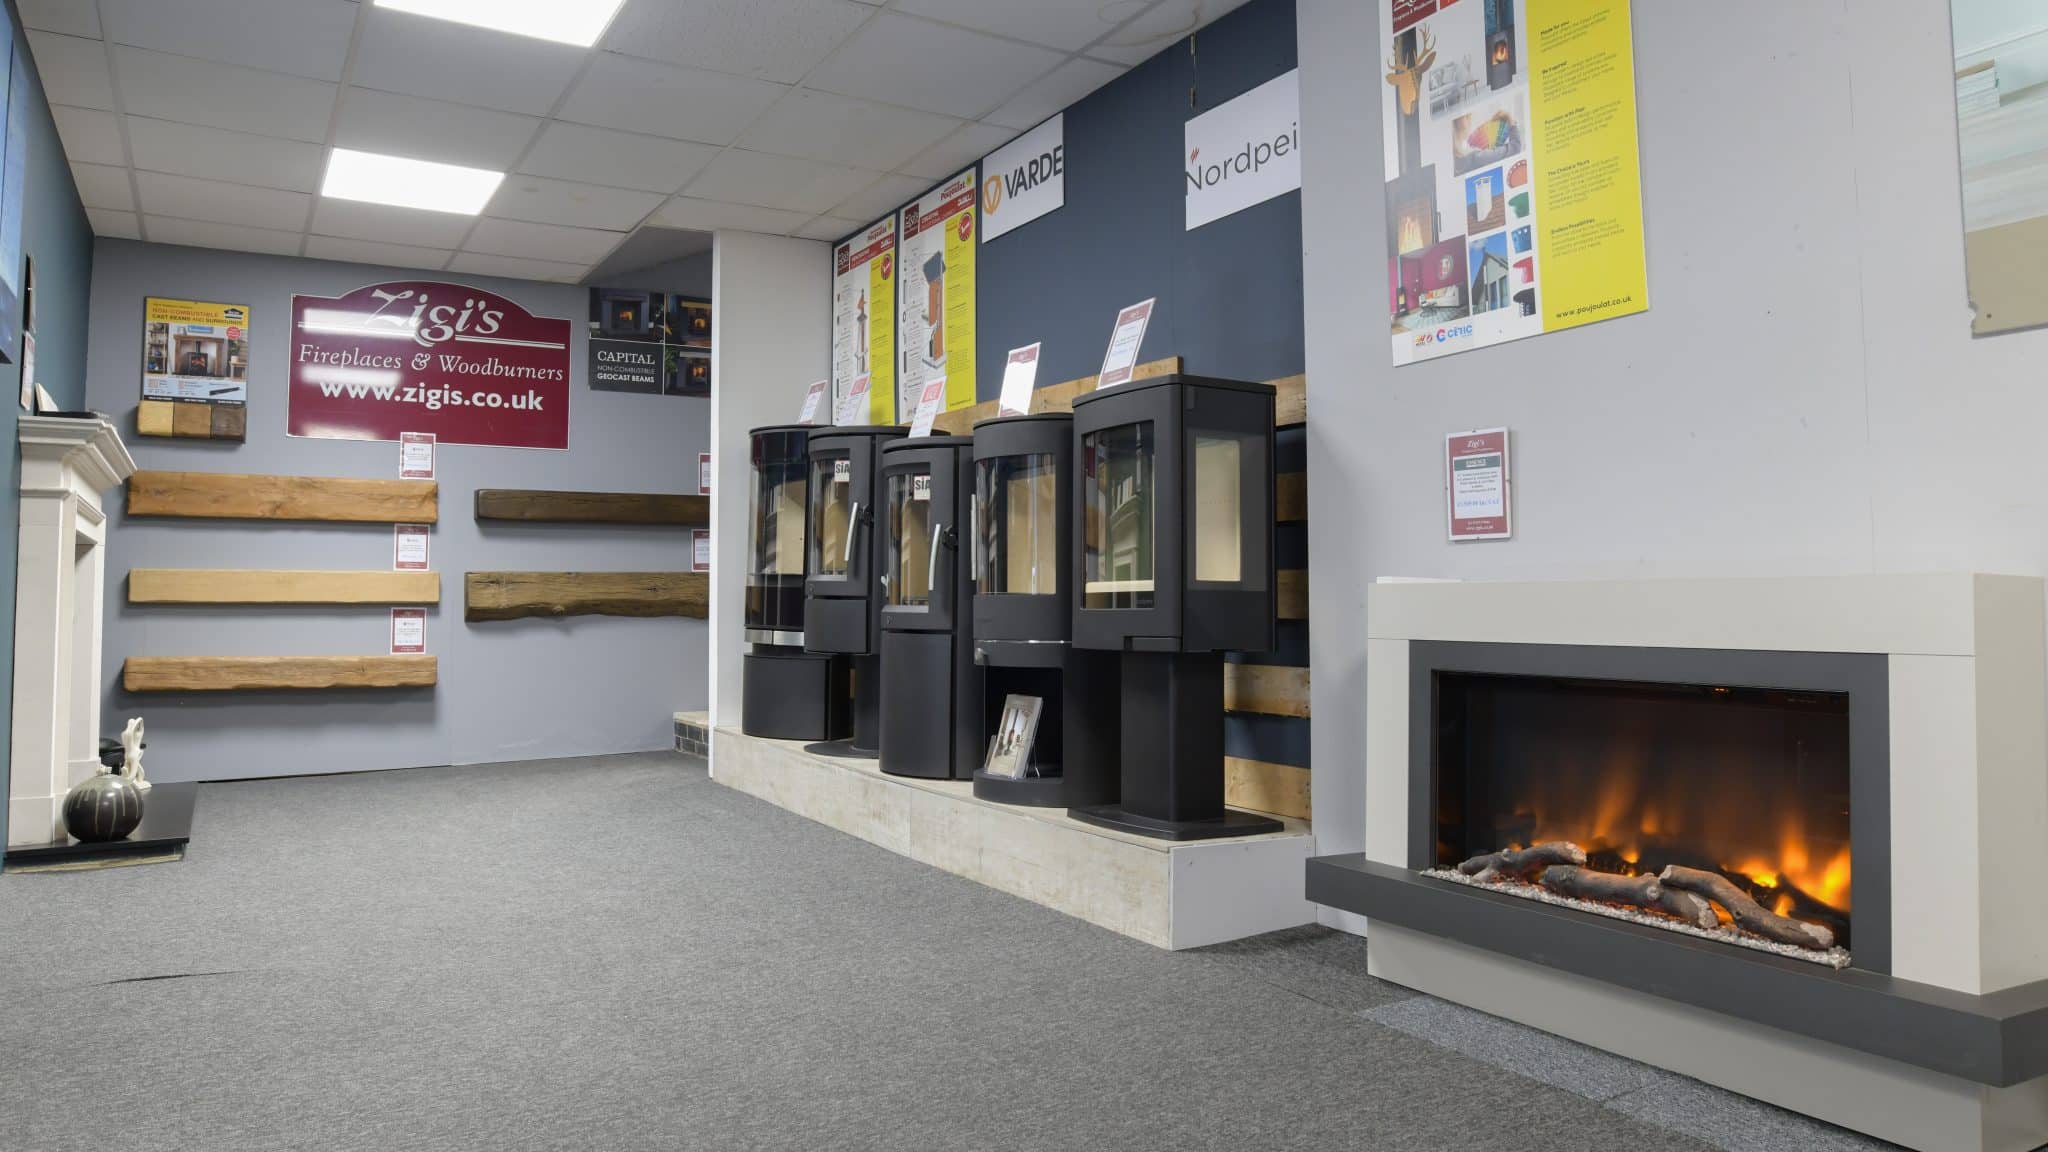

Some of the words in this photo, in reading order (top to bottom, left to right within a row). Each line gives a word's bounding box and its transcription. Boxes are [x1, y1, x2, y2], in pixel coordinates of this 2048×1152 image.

[1004, 144, 1063, 199] VARDE
[362, 288, 505, 348] Zigi's
[1555, 294, 1633, 319] www.poujoulat.co.uk
[297, 343, 402, 370] Fireplaces
[410, 352, 431, 371] &
[439, 353, 565, 381] Woodburners
[597, 350, 656, 365] CAPITAL
[597, 364, 656, 375] NON-COMBUSTIBLE
[596, 372, 631, 381] GEOCAST
[631, 374, 656, 384] BEAMS
[319, 381, 545, 411] www.zigis.co.uk
